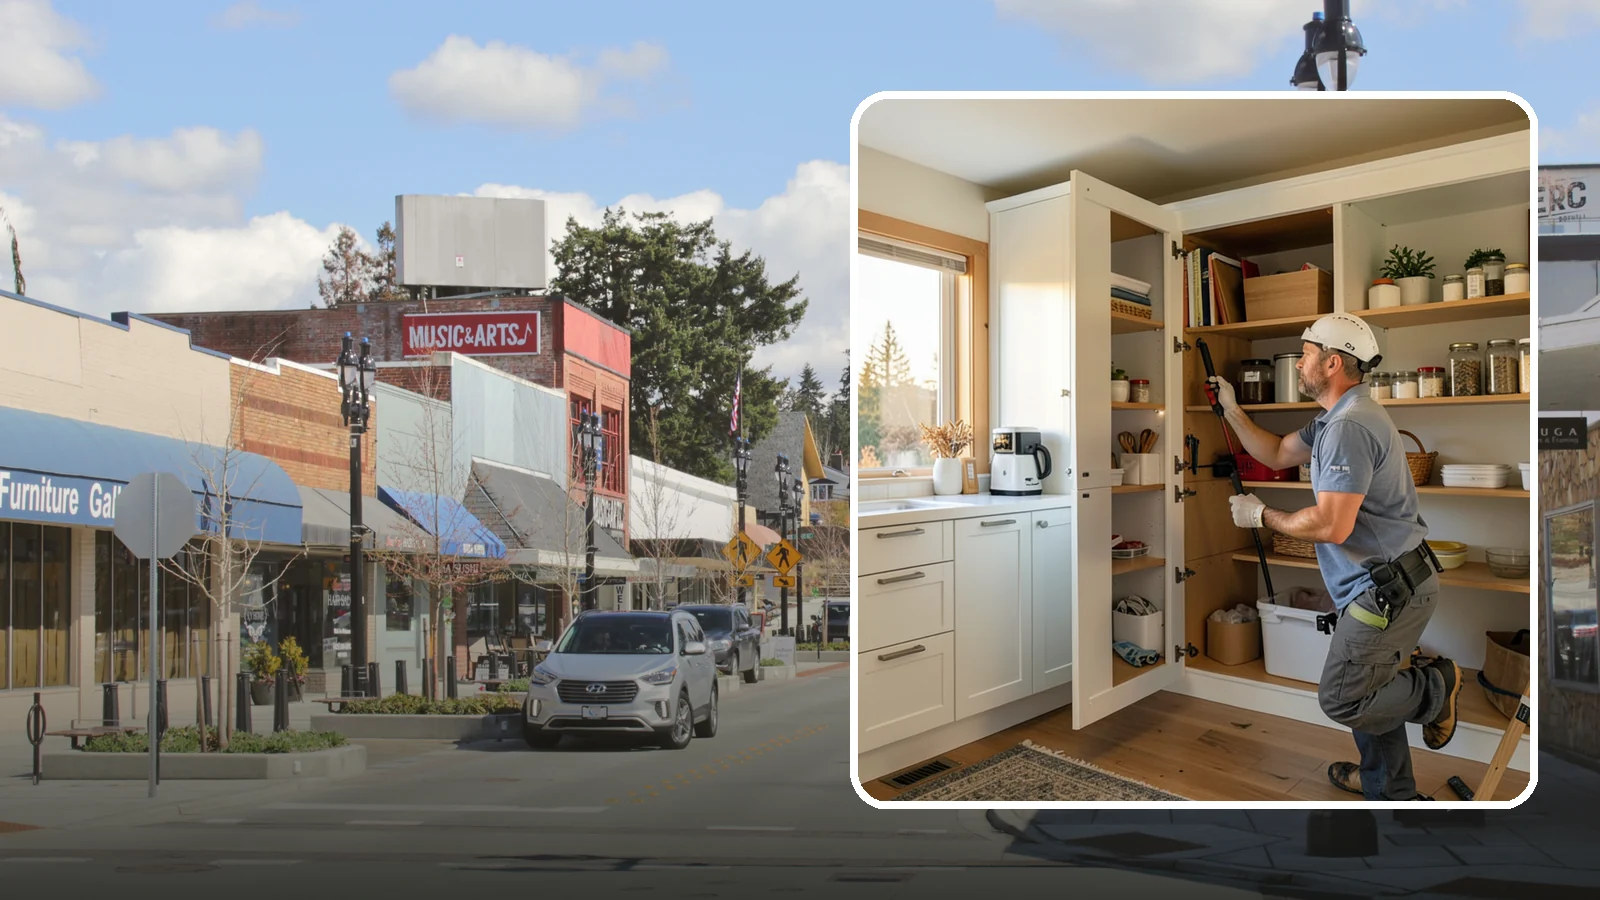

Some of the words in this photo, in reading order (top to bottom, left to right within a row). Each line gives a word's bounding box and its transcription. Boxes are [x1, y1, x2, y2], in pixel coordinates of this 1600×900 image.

[0, 472, 79, 515] Furniture
[90, 482, 121, 519] Gal
[453, 563, 480, 574] SUSHI
